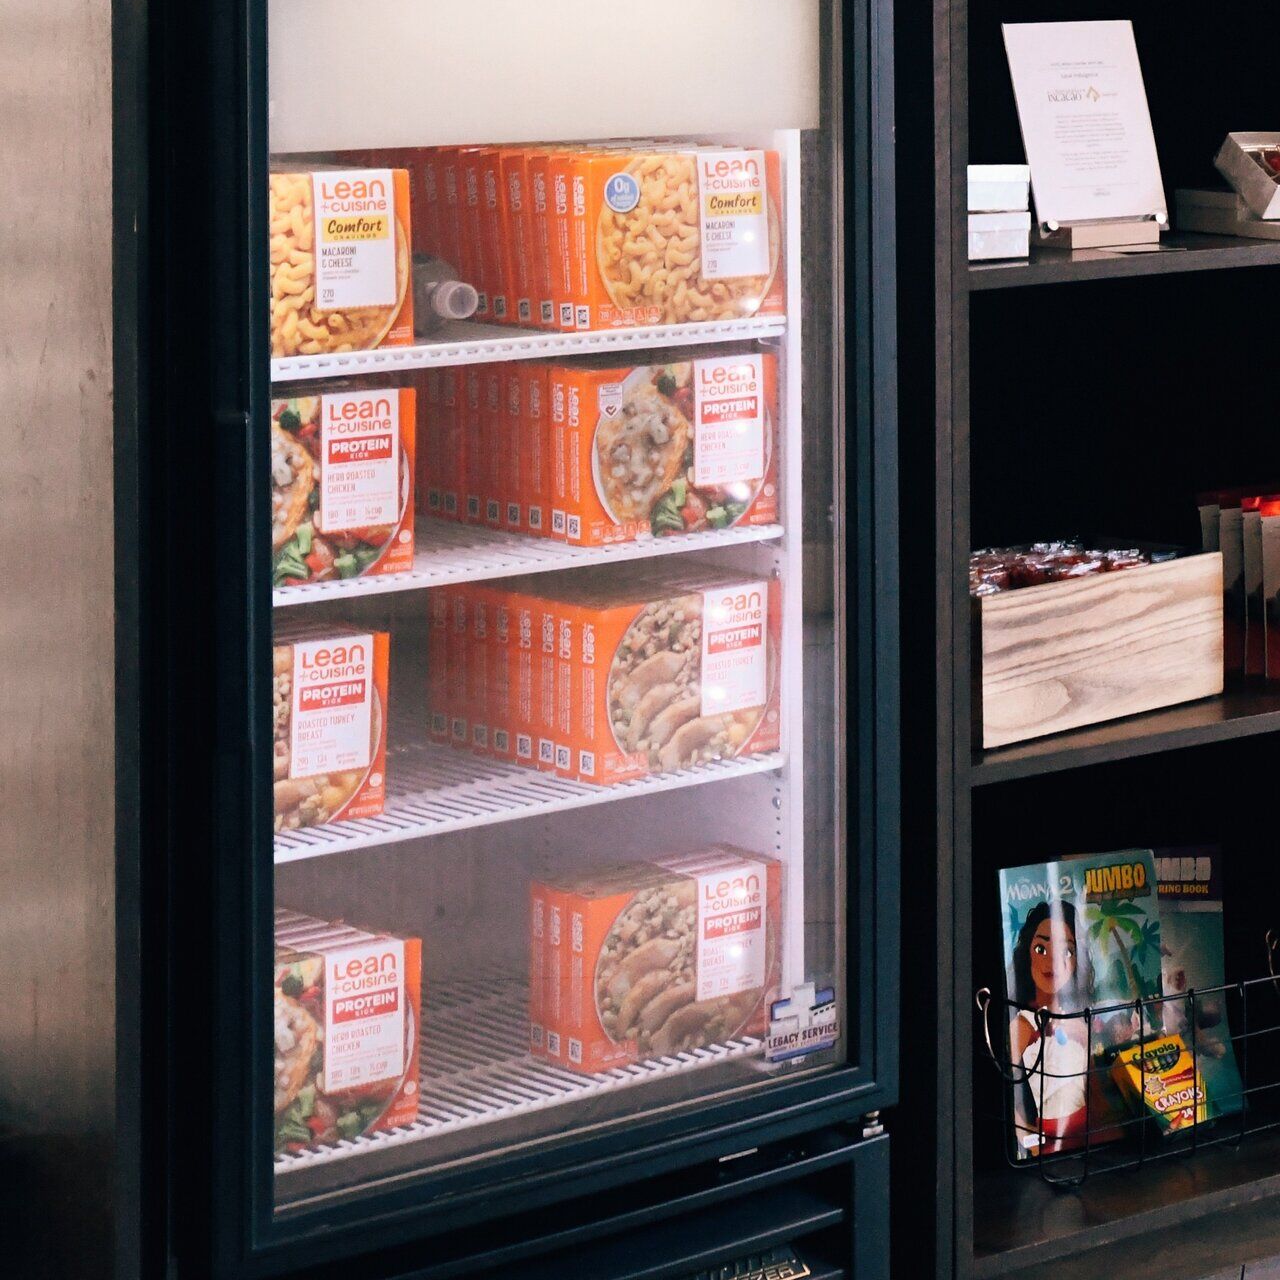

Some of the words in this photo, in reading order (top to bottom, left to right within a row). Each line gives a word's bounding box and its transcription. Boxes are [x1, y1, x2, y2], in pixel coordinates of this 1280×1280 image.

[704, 159, 759, 178] Lean
[321, 180, 385, 199] Lean
[614, 177, 630, 195] 0g
[712, 177, 760, 189] cuisine
[331, 200, 387, 212] cuisine
[710, 195, 757, 210] Comfort
[327, 218, 382, 234] Comfort
[705, 221, 736, 230] MACARONI
[711, 232, 732, 241] CHEESE
[321, 247, 357, 256] MACARONI
[328, 258, 352, 268] CHEESE
[322, 289, 334, 298] 270
[701, 363, 756, 385] Lean
[709, 381, 756, 397] cuisine
[329, 399, 391, 421] Lean
[703, 400, 755, 415] PROTEIN
[338, 419, 391, 433] cuisine
[331, 437, 389, 455] PROTEIN
[327, 472, 345, 483] HERB
[346, 470, 376, 482] ROASTED
[327, 484, 356, 494] CHICKEN
[710, 627, 759, 646] PROTEIN
[302, 644, 364, 669] Lean
[310, 664, 365, 680] cuisine
[303, 683, 362, 702] PROTEIN
[298, 716, 328, 730] ROASTED
[329, 712, 355, 726] TURKEY
[298, 730, 323, 742] BREAST
[1155, 857, 1211, 881] UMBO
[705, 874, 760, 901] Lean
[1059, 876, 1074, 894] 2
[1085, 863, 1146, 895] JUMBO
[1183, 883, 1209, 894] BOOK
[707, 911, 758, 931] PROTEIN
[334, 952, 396, 981] Lean
[342, 971, 397, 993] cuisine
[336, 992, 395, 1014] PROTEIN
[350, 1024, 381, 1039] ROASTED
[769, 1032, 800, 1049] LEGACY
[801, 1021, 838, 1040] SERVICE
[1132, 1042, 1181, 1063] Cayola
[1154, 1086, 1204, 1111] CRAYONS
